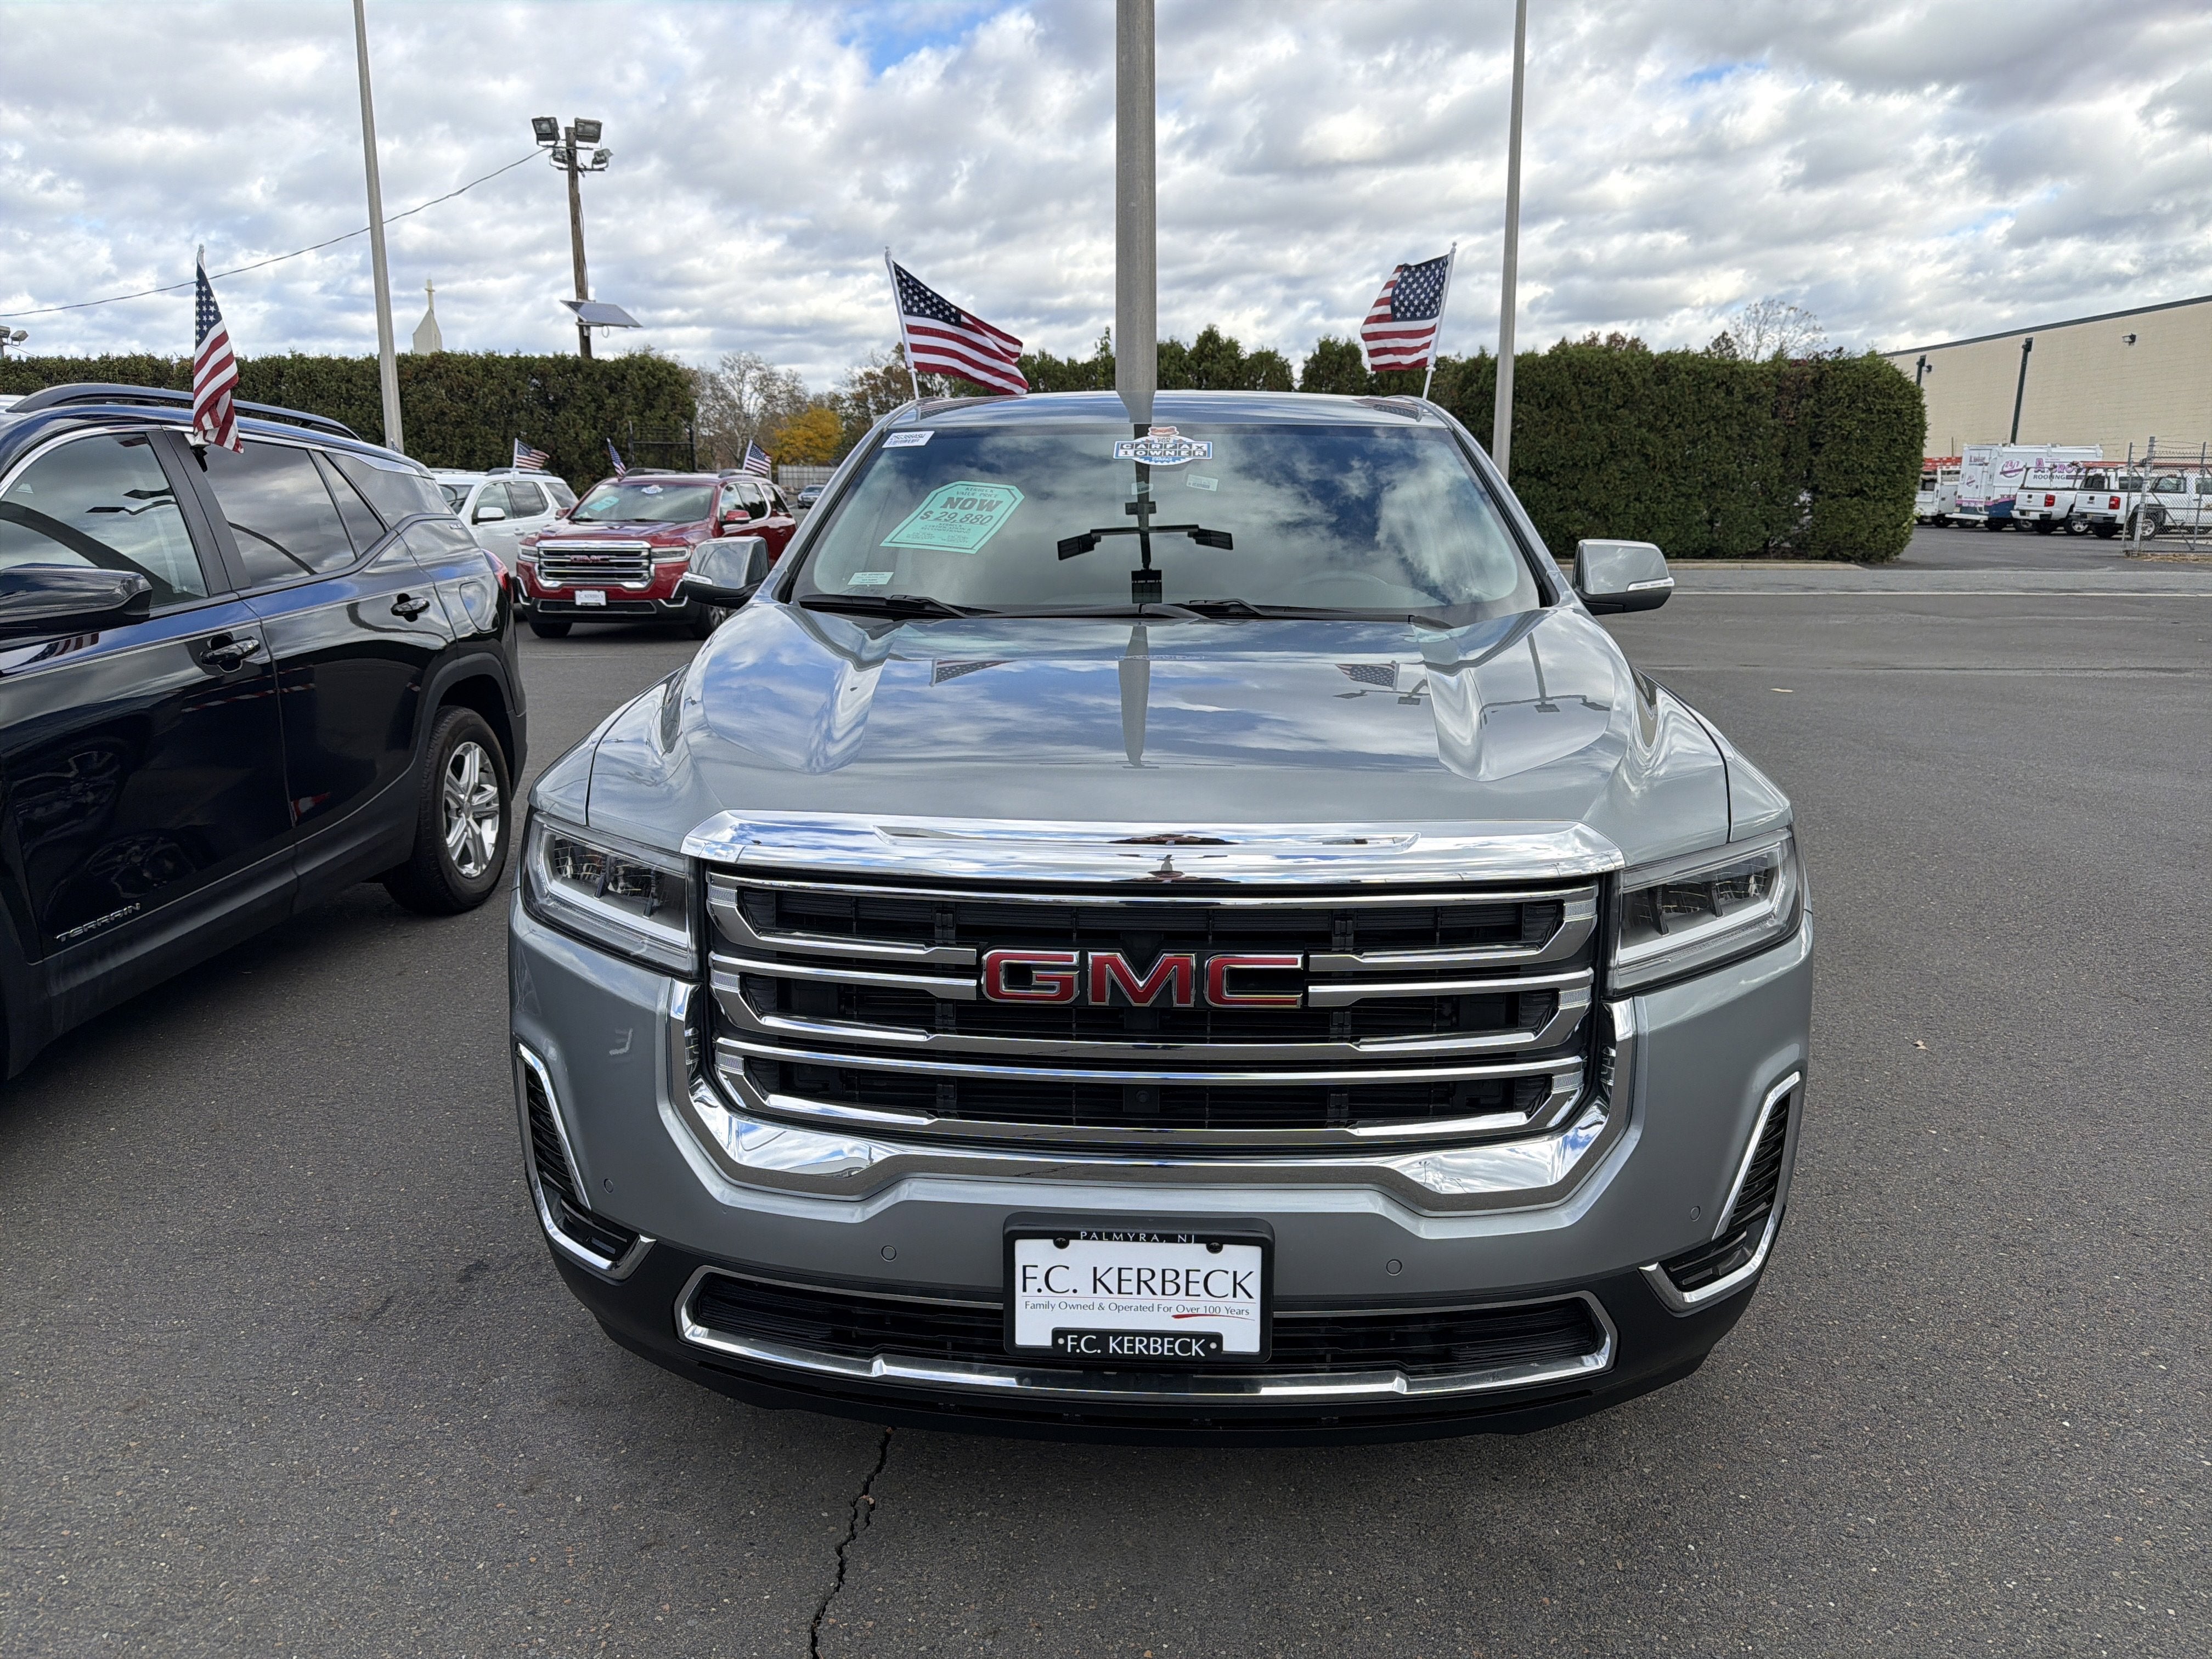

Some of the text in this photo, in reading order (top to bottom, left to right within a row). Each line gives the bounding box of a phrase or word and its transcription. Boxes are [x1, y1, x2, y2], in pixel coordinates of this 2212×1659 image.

[940, 497, 1004, 512] NOW
[934, 511, 994, 524] 29,880
[571, 555, 610, 563] GMC
[56, 902, 141, 942] TERRAIN
[981, 949, 1304, 1008] GMC
[1080, 1232, 1195, 1244] PALMYRA, NJ
[1022, 1265, 1255, 1300] F.C. KERBECK
[1025, 1301, 1250, 1316] Family Owned & Operated For Over 100 Years
[1066, 1335, 1205, 1357] F.C. KERBECK
